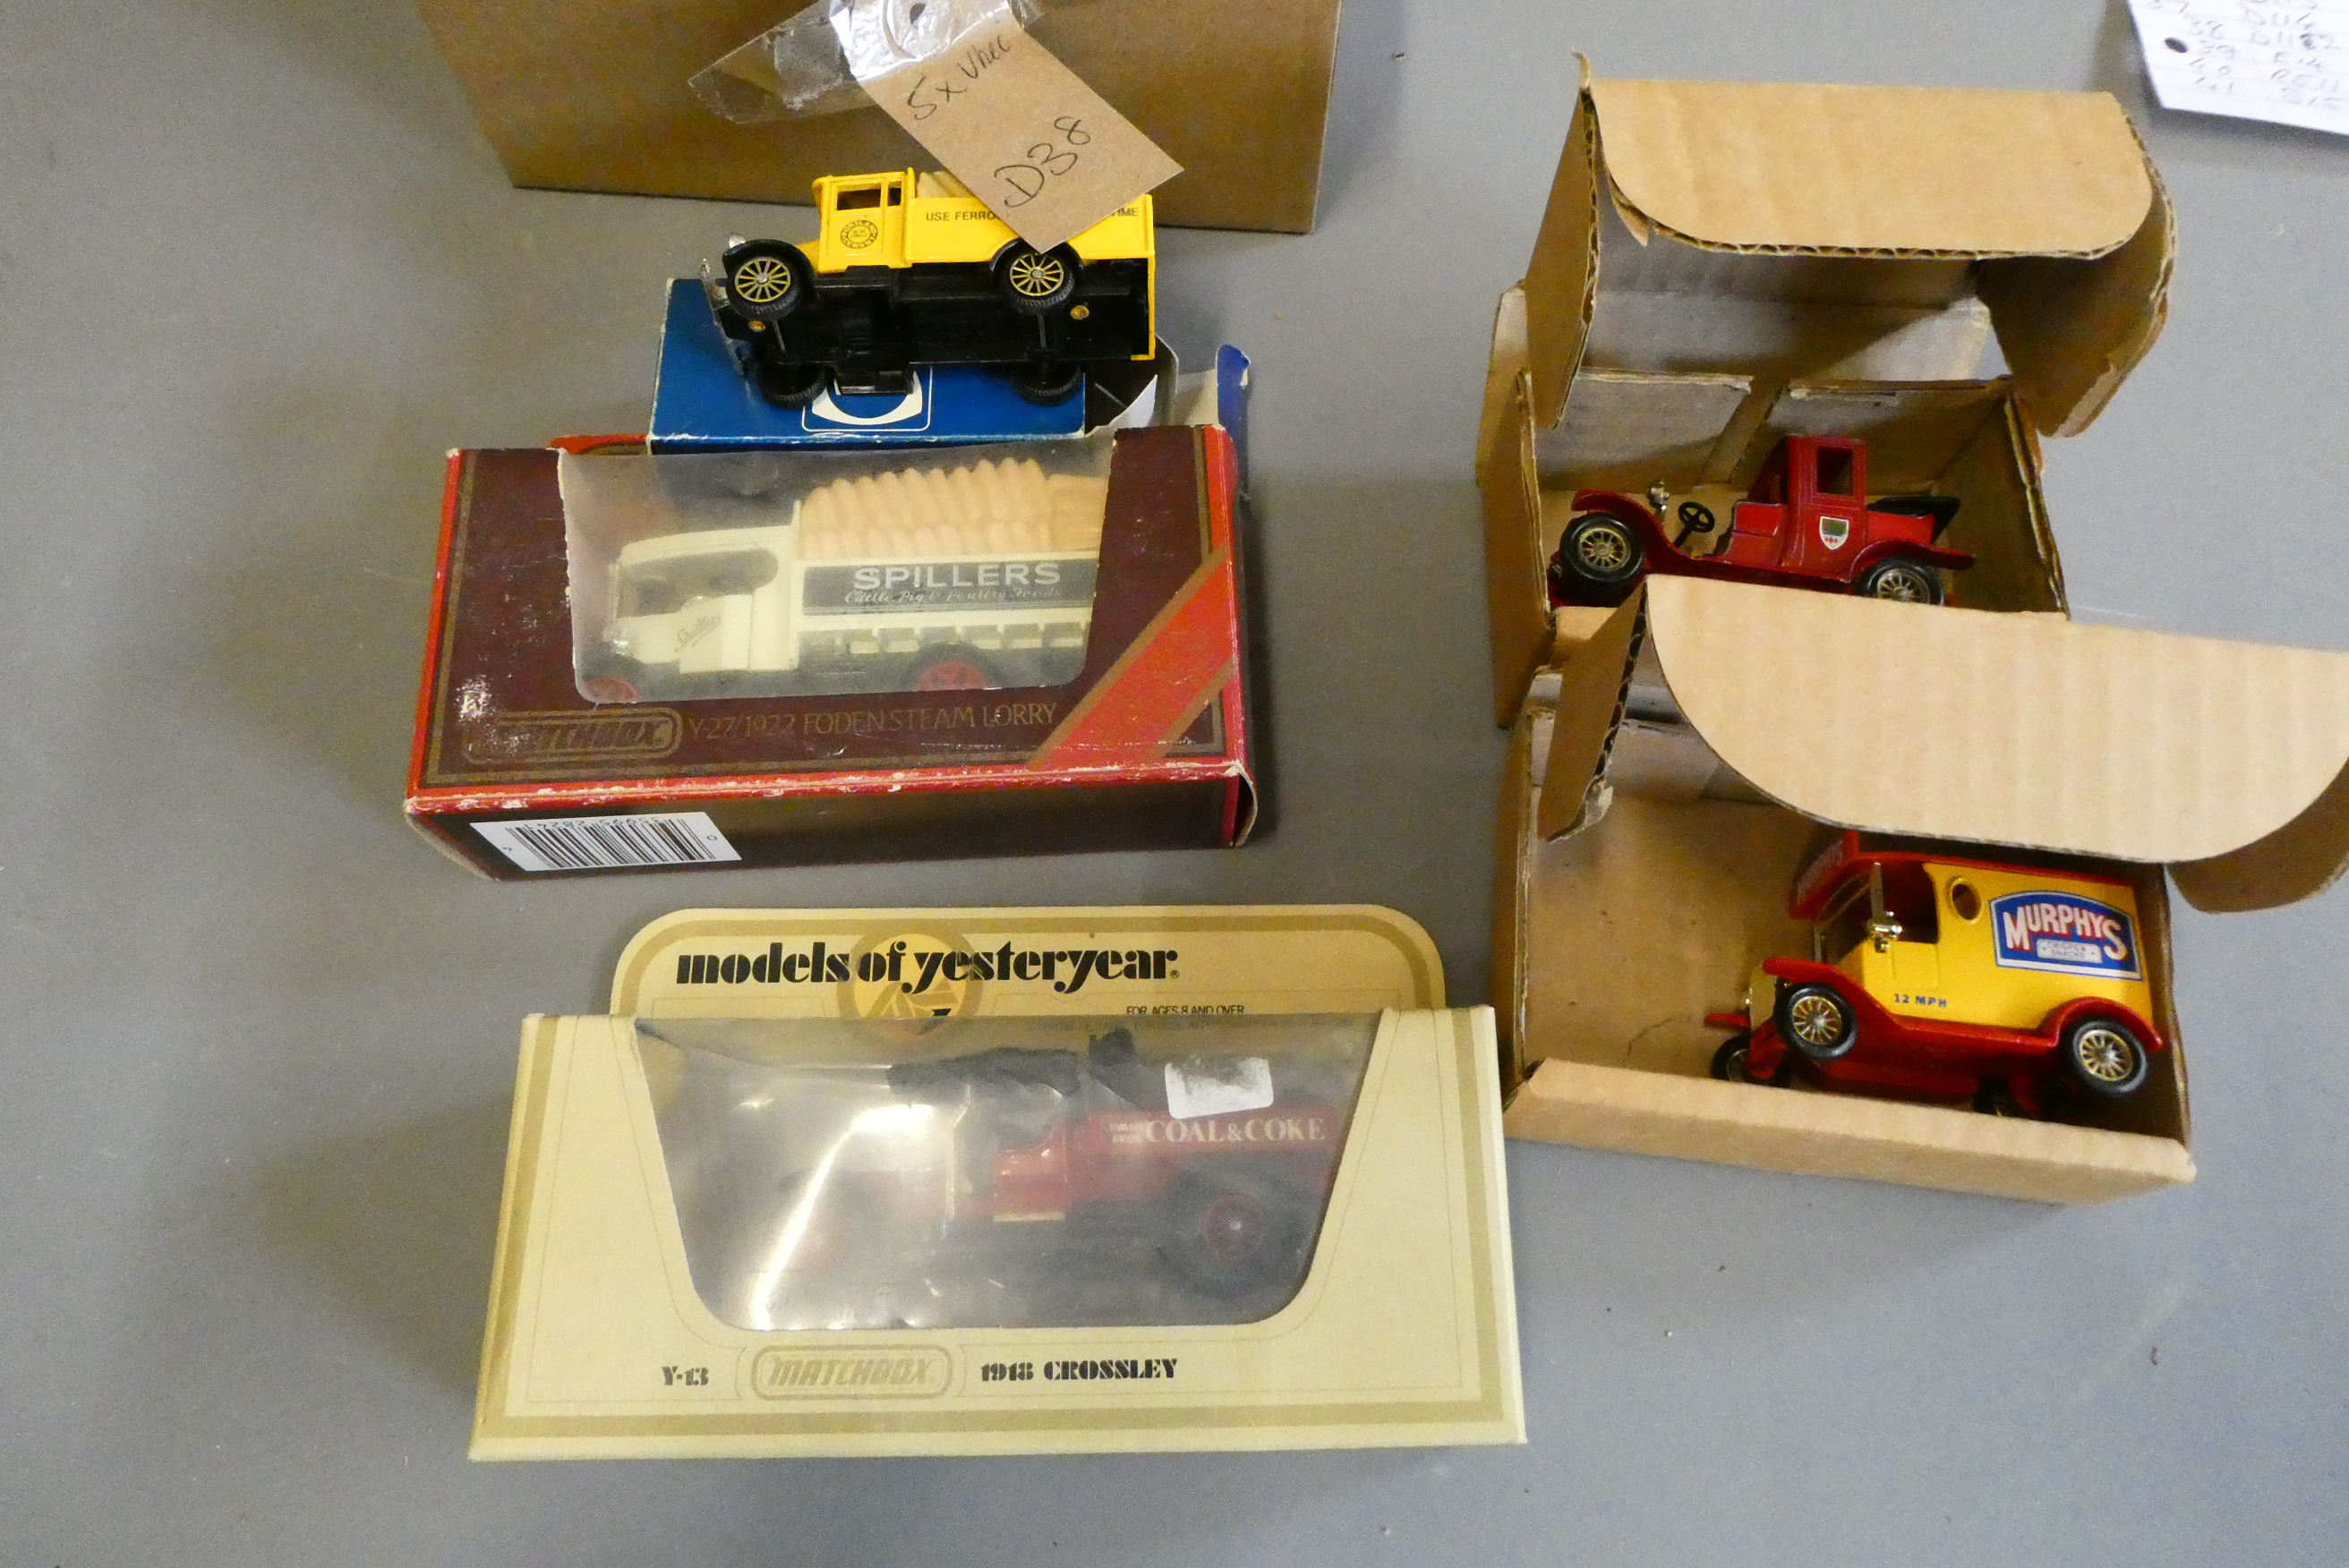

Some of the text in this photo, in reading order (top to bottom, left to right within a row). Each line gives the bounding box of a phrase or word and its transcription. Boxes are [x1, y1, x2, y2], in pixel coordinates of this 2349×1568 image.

[994, 115, 1091, 208] D38
[926, 209, 995, 221] USE FERRO
[1111, 207, 1139, 217] IME
[853, 562, 1061, 591] SPILLERS
[805, 712, 885, 735] FODEN
[891, 706, 976, 731] STEAM
[982, 702, 1058, 727] LORRY
[676, 942, 850, 984] models
[857, 941, 907, 984] of
[1126, 1005, 1245, 1016] FOR AGES 8 AND OVER
[1894, 993, 1947, 1008] 12 MPH
[662, 1354, 1179, 1388] Y-13 MATCHBOX 1918 CROSSLEY
